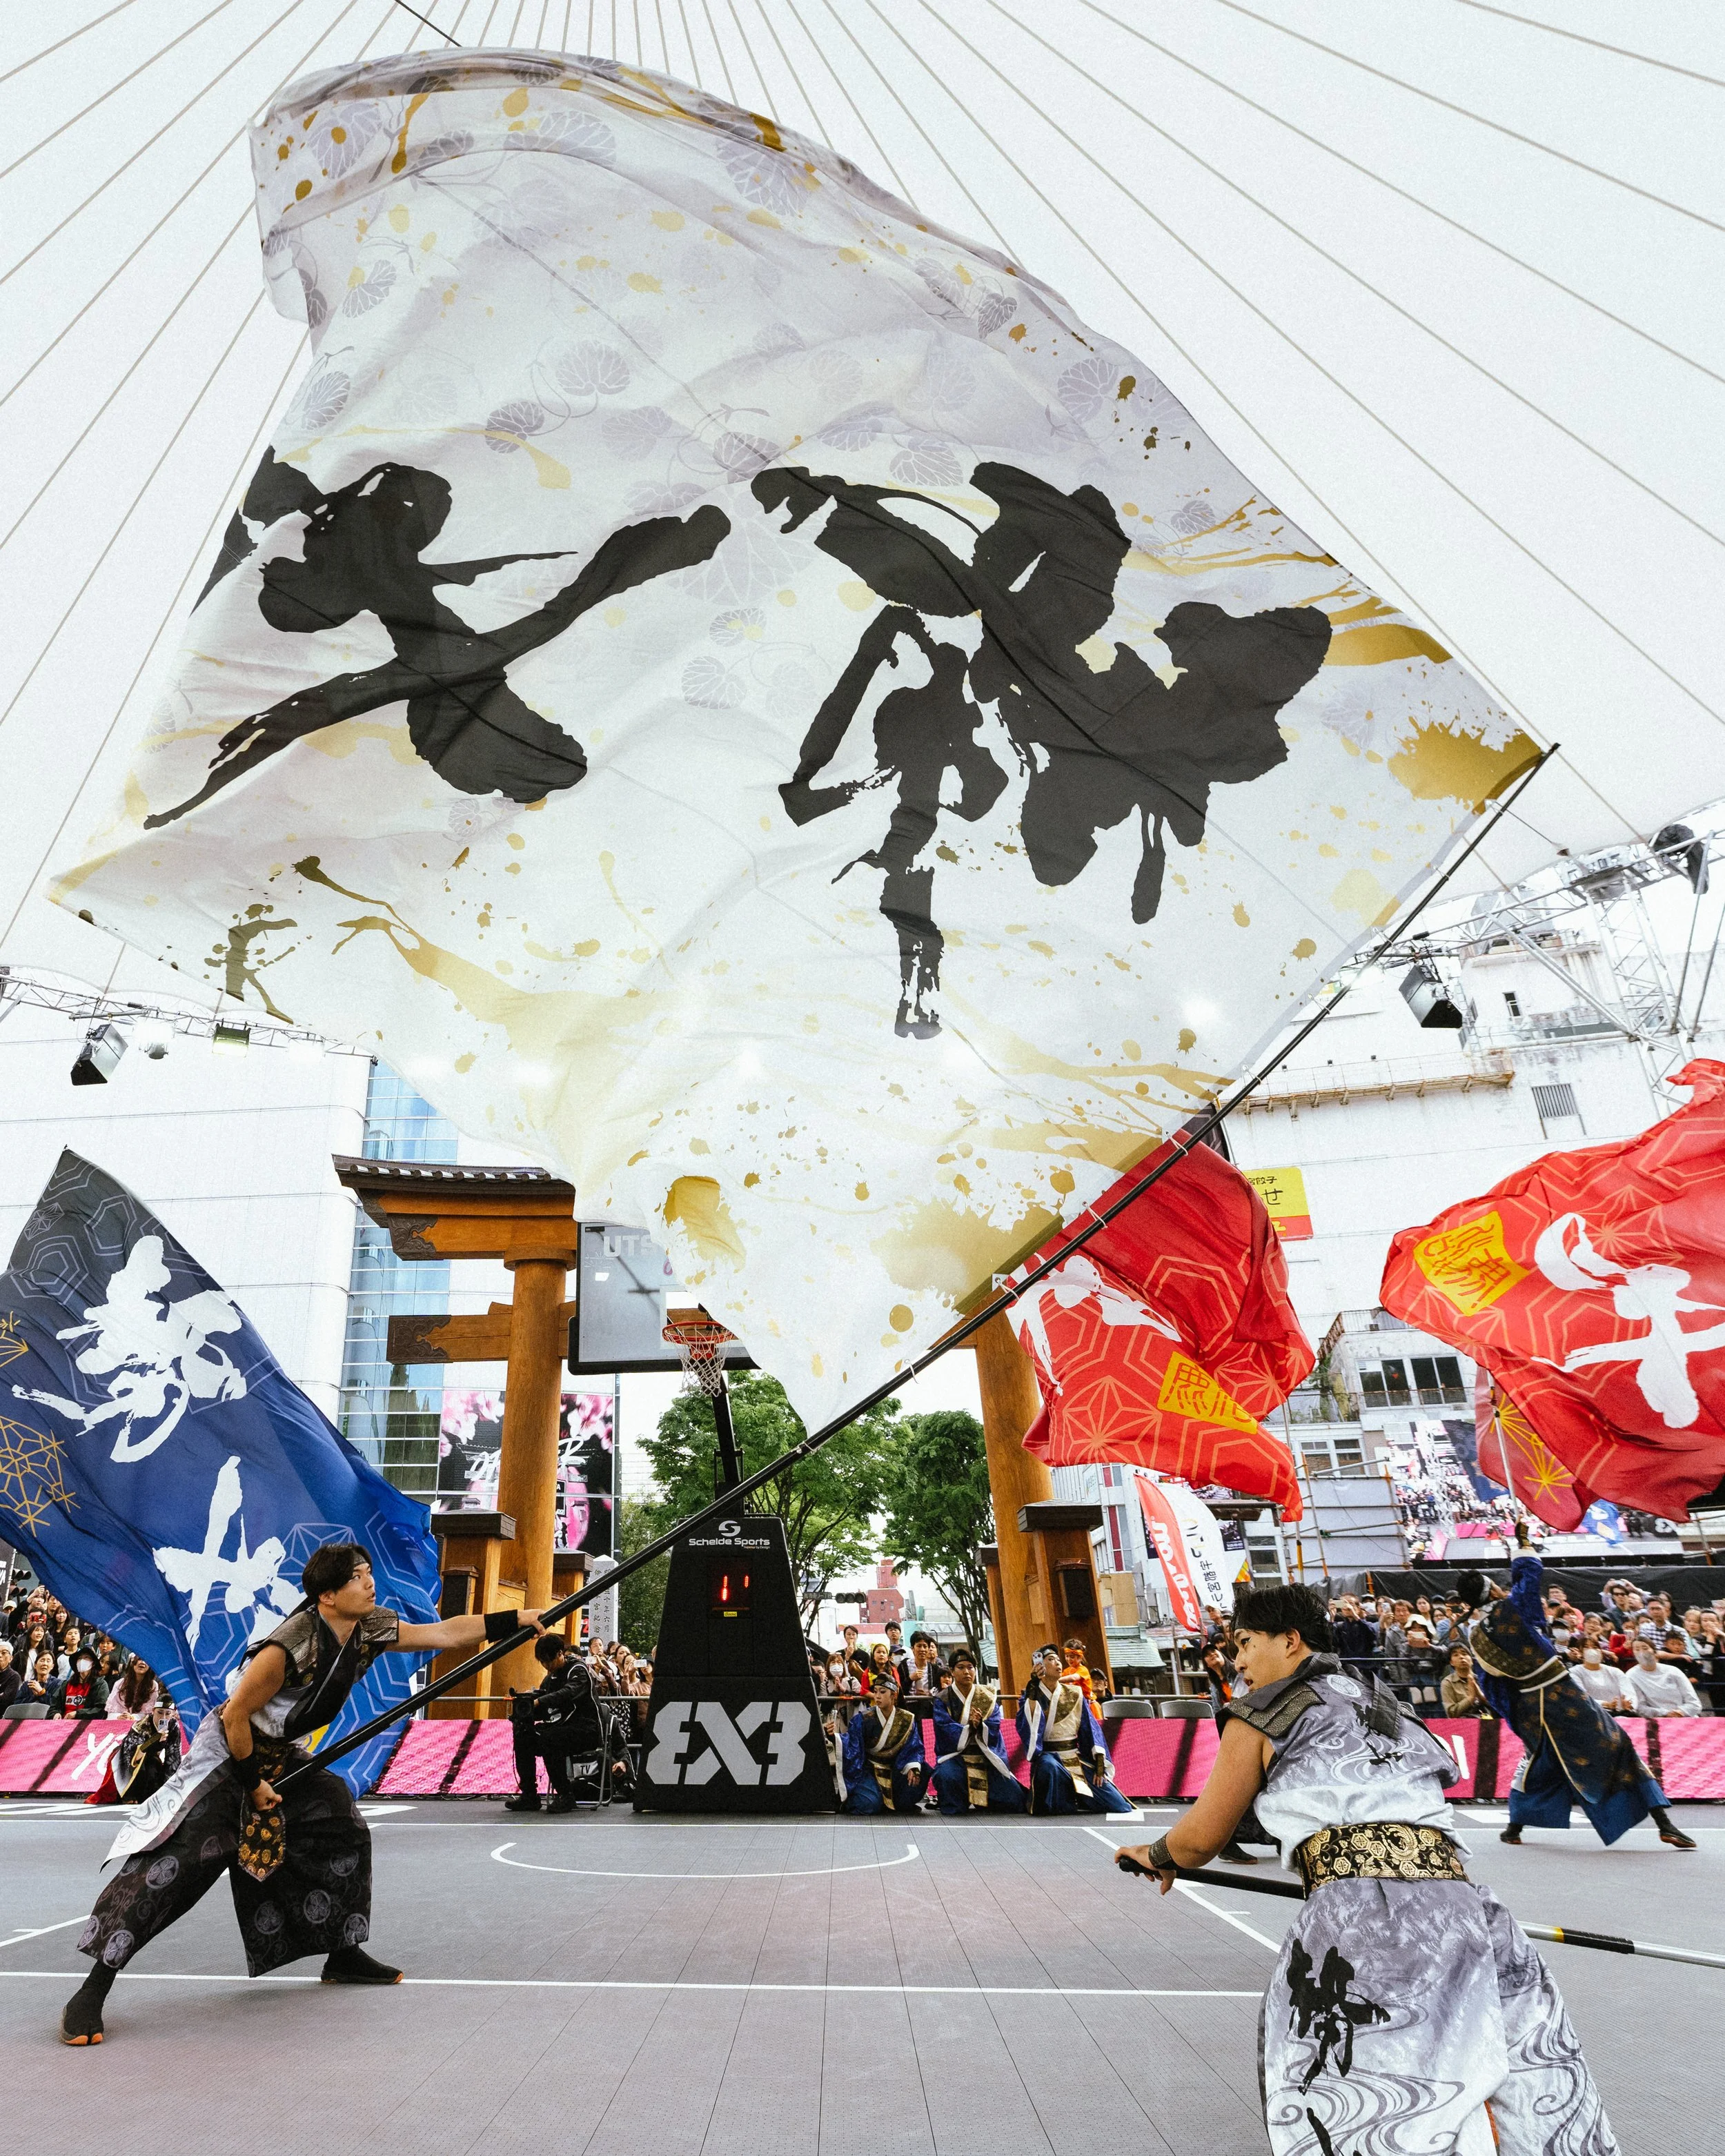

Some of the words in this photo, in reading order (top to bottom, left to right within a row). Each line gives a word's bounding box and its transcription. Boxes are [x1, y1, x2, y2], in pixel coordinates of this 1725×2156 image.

[689, 1538, 732, 1546] Schelde
[734, 1538, 771, 1547] Sports
[580, 1764, 591, 1774] TV
